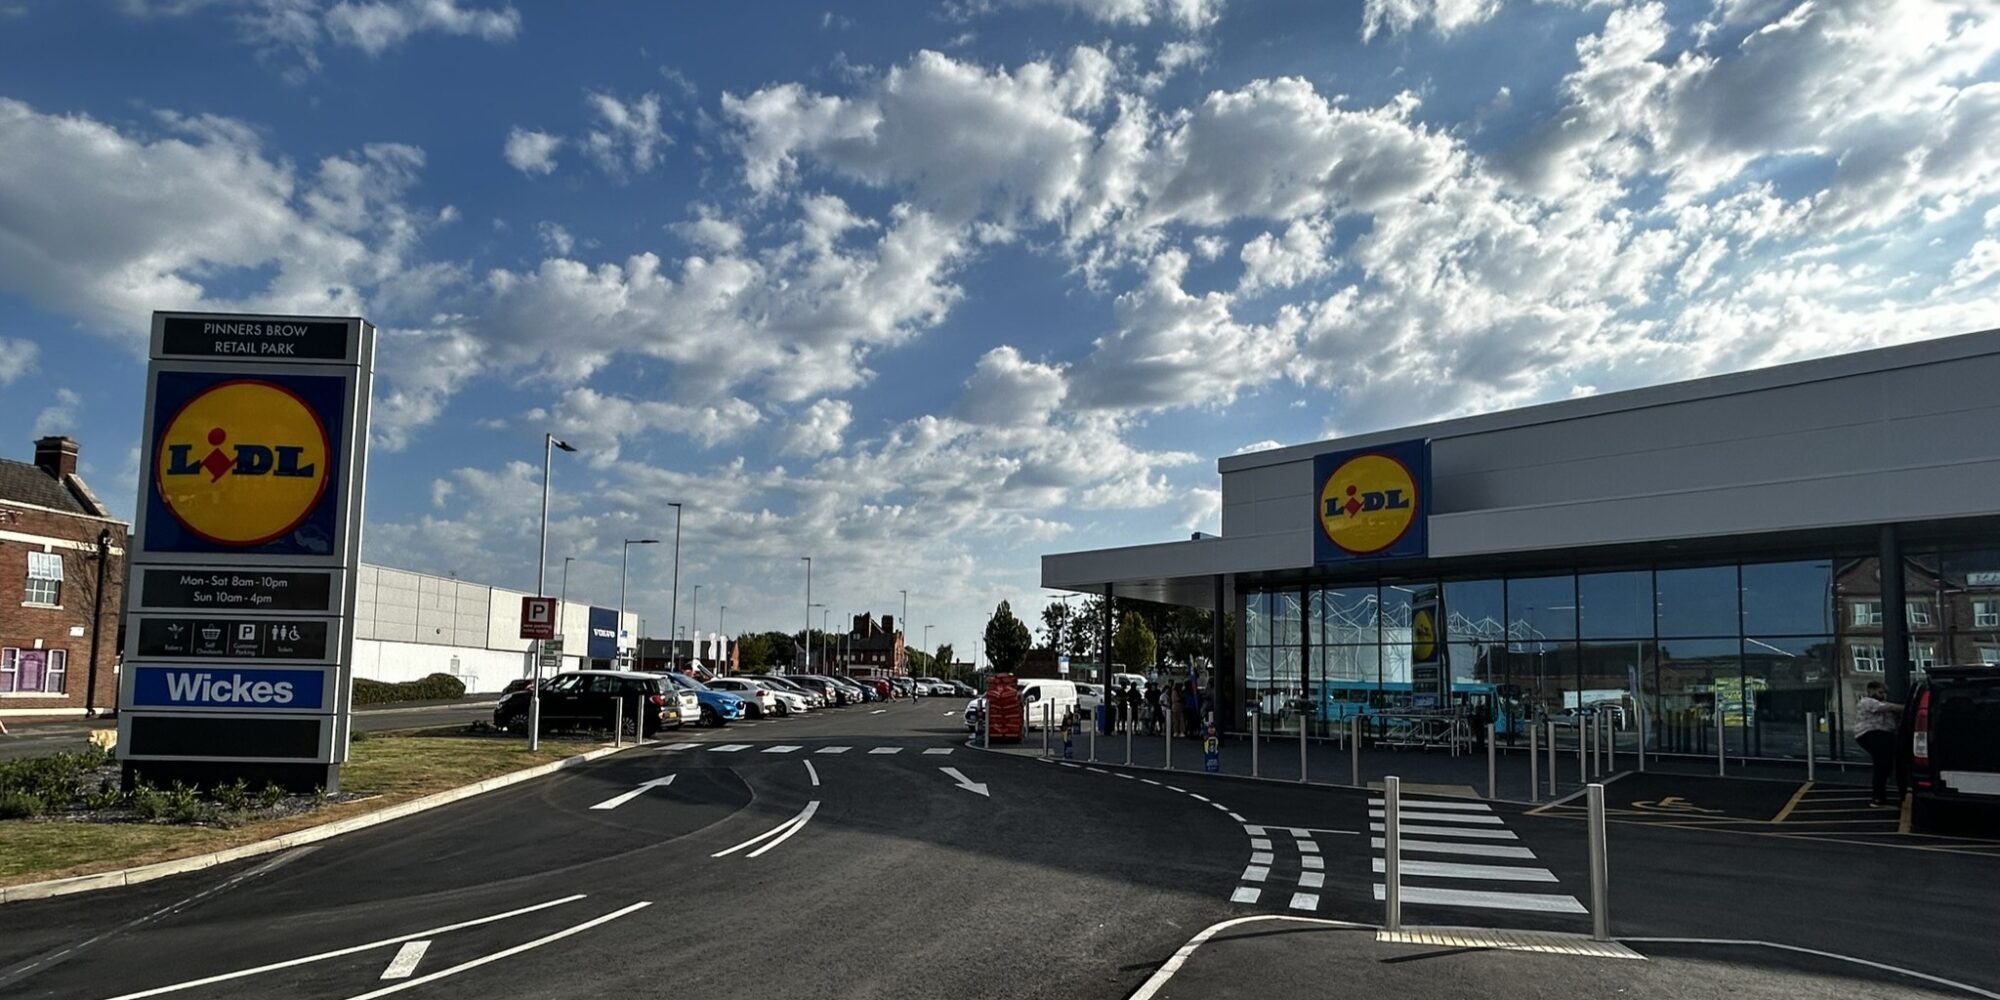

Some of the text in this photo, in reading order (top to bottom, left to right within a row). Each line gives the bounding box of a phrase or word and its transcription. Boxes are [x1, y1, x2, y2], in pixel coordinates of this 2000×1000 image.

[203, 322, 308, 337] PINNERS BROW
[215, 342, 295, 355] RETAIL PARK
[193, 591, 212, 602] Sun
[532, 604, 545, 619] P
[592, 628, 616, 638] VOLVO
[235, 649, 256, 657] Parking
[166, 672, 294, 703] Wickes
